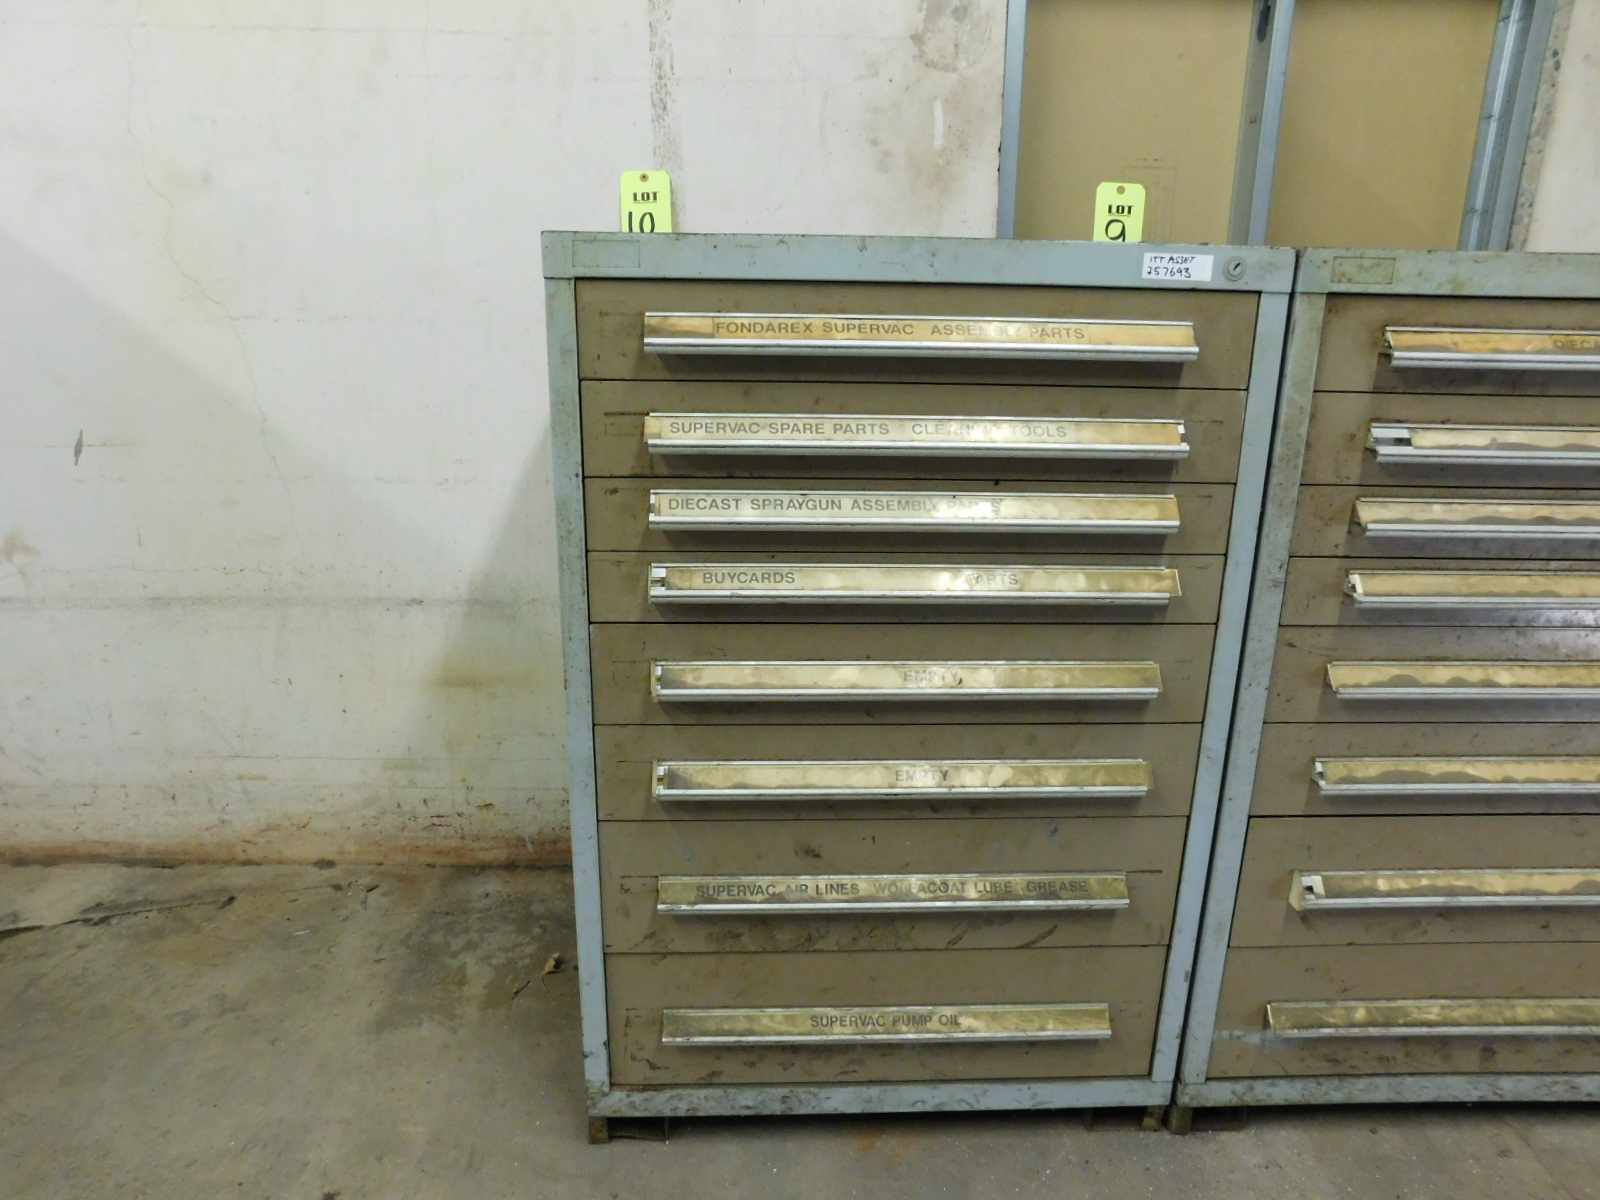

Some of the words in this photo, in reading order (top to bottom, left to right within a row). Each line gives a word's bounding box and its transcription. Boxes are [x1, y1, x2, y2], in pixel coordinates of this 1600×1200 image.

[633, 191, 659, 202] LOT
[1107, 204, 1134, 215] LOT
[628, 211, 655, 234] 10
[1104, 218, 1127, 242] 9
[1167, 255, 1196, 265] ASSET
[1147, 266, 1192, 279] 257693
[715, 321, 814, 335] FONDAREX
[821, 321, 915, 336] SUPERVAC
[1028, 326, 1085, 340] PARTS
[669, 421, 761, 435] SUPERVAC
[768, 422, 826, 436] SPARE
[832, 424, 890, 437] PARTS
[911, 423, 1004, 437] CLEANN
[1012, 425, 1068, 438] TOOLS
[668, 498, 742, 511] DIECAST
[750, 498, 842, 511] SPRAYGUN
[850, 499, 939, 512] ASSEMBLY
[946, 499, 1002, 514] PARS
[702, 572, 796, 585] BUYCARDS
[966, 572, 1019, 586] ARTS
[895, 769, 949, 781] EMPTY
[696, 884, 776, 898] SUPERVAC
[815, 883, 860, 896] LINES
[974, 882, 1013, 894] LUBE
[1026, 881, 1088, 893] GREASE
[810, 1015, 886, 1028] SUPERVAC
[892, 1014, 932, 1027] PUMP
[938, 1014, 962, 1026] OIL
